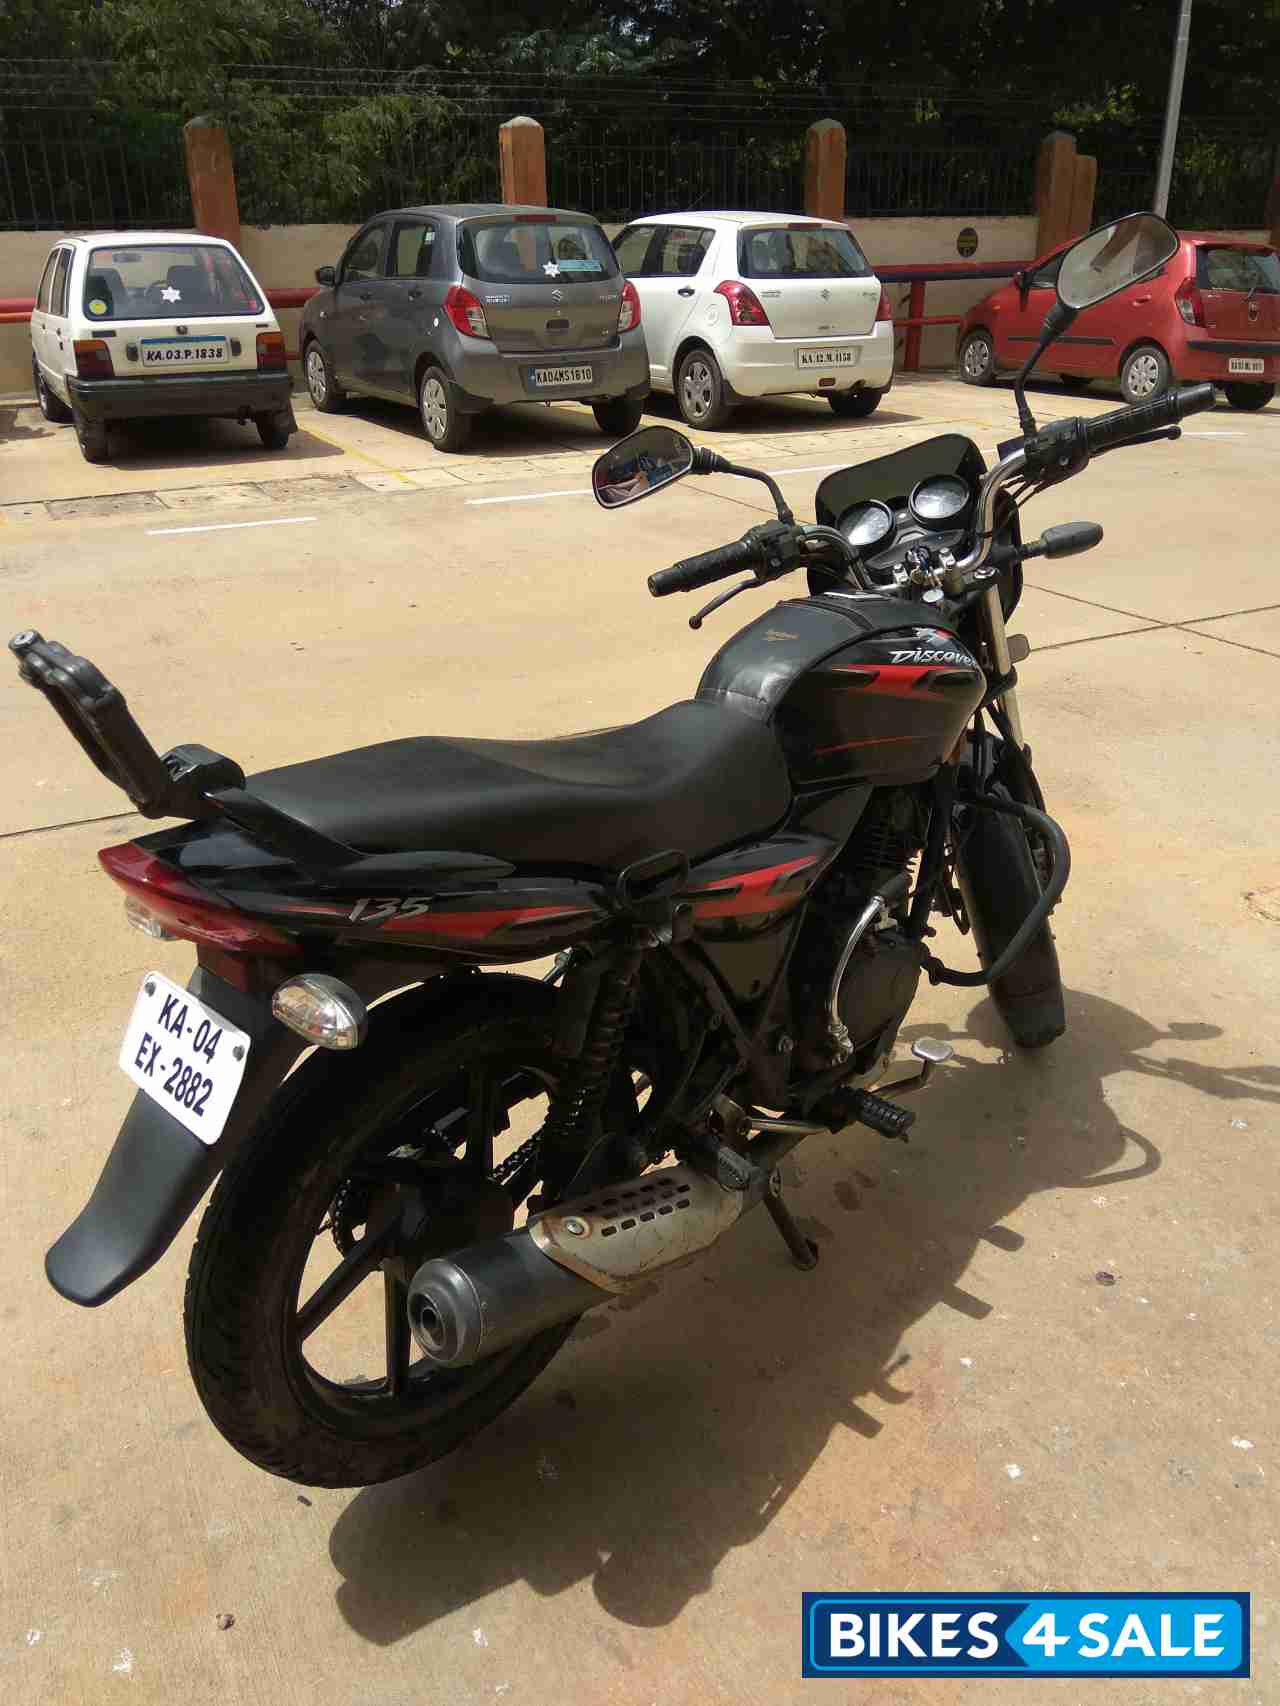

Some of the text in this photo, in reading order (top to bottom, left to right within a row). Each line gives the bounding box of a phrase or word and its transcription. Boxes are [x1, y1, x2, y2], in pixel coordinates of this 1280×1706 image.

[348, 897, 434, 922] 135
[158, 994, 223, 1064] KA-04
[135, 1032, 213, 1117] EX-2882
